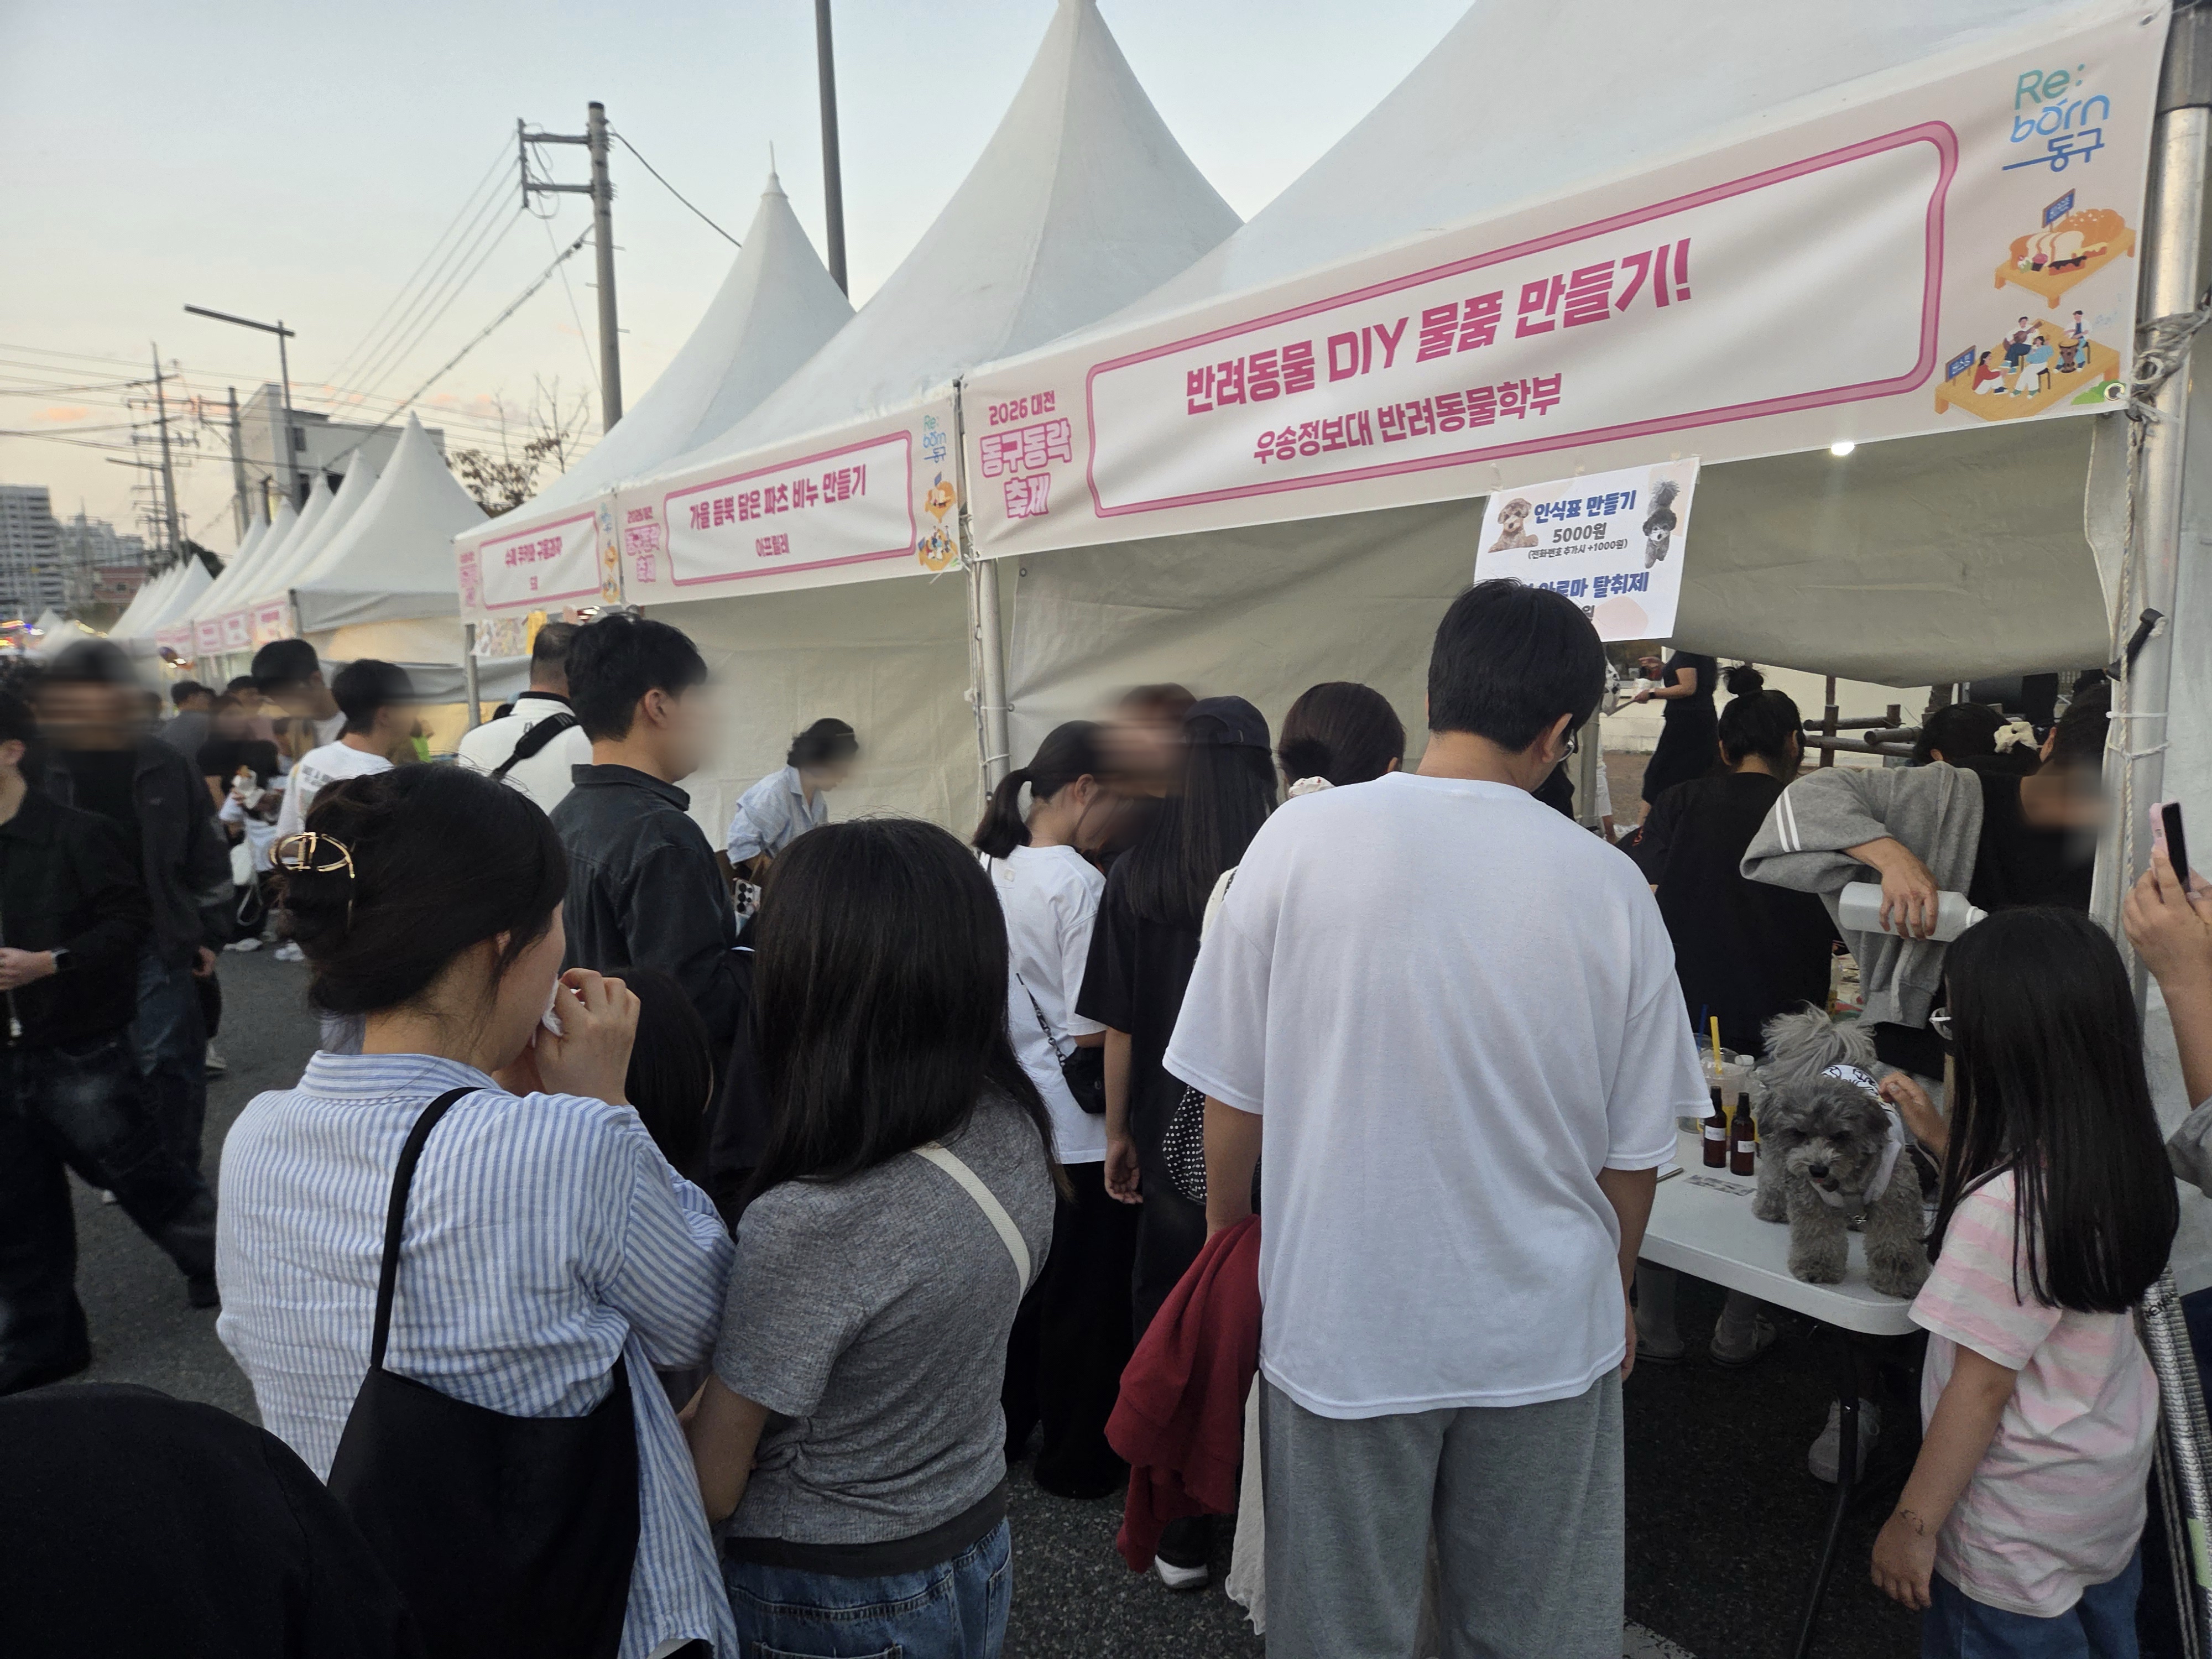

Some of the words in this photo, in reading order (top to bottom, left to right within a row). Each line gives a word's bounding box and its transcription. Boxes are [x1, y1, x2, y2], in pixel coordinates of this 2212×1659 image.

[2014, 64, 2085, 109] Re:
[2010, 94, 2110, 143] born
[2002, 128, 2105, 173] 동구
[1186, 340, 1316, 415] 반려동물
[1327, 316, 1410, 383] DIY
[1416, 290, 1504, 363] 물품
[1514, 238, 1692, 339] 만들기!
[989, 398, 1028, 426] 2026
[1031, 390, 1056, 416] 대전
[1253, 408, 1371, 464] 우송정보대
[1378, 373, 1563, 440] 반려동물학부
[980, 417, 1073, 478] 동구동락
[690, 500, 711, 530] 가을
[713, 495, 735, 527] 듬뿍
[738, 490, 761, 521] 담은
[792, 477, 819, 509] 비누
[822, 464, 866, 504] 만들기
[1004, 472, 1051, 519] 축제
[1534, 499, 1582, 524] 인식표
[1586, 490, 1637, 518] 만들기
[1552, 523, 1607, 544] 5000원
[1593, 572, 1650, 598] 탈취제
